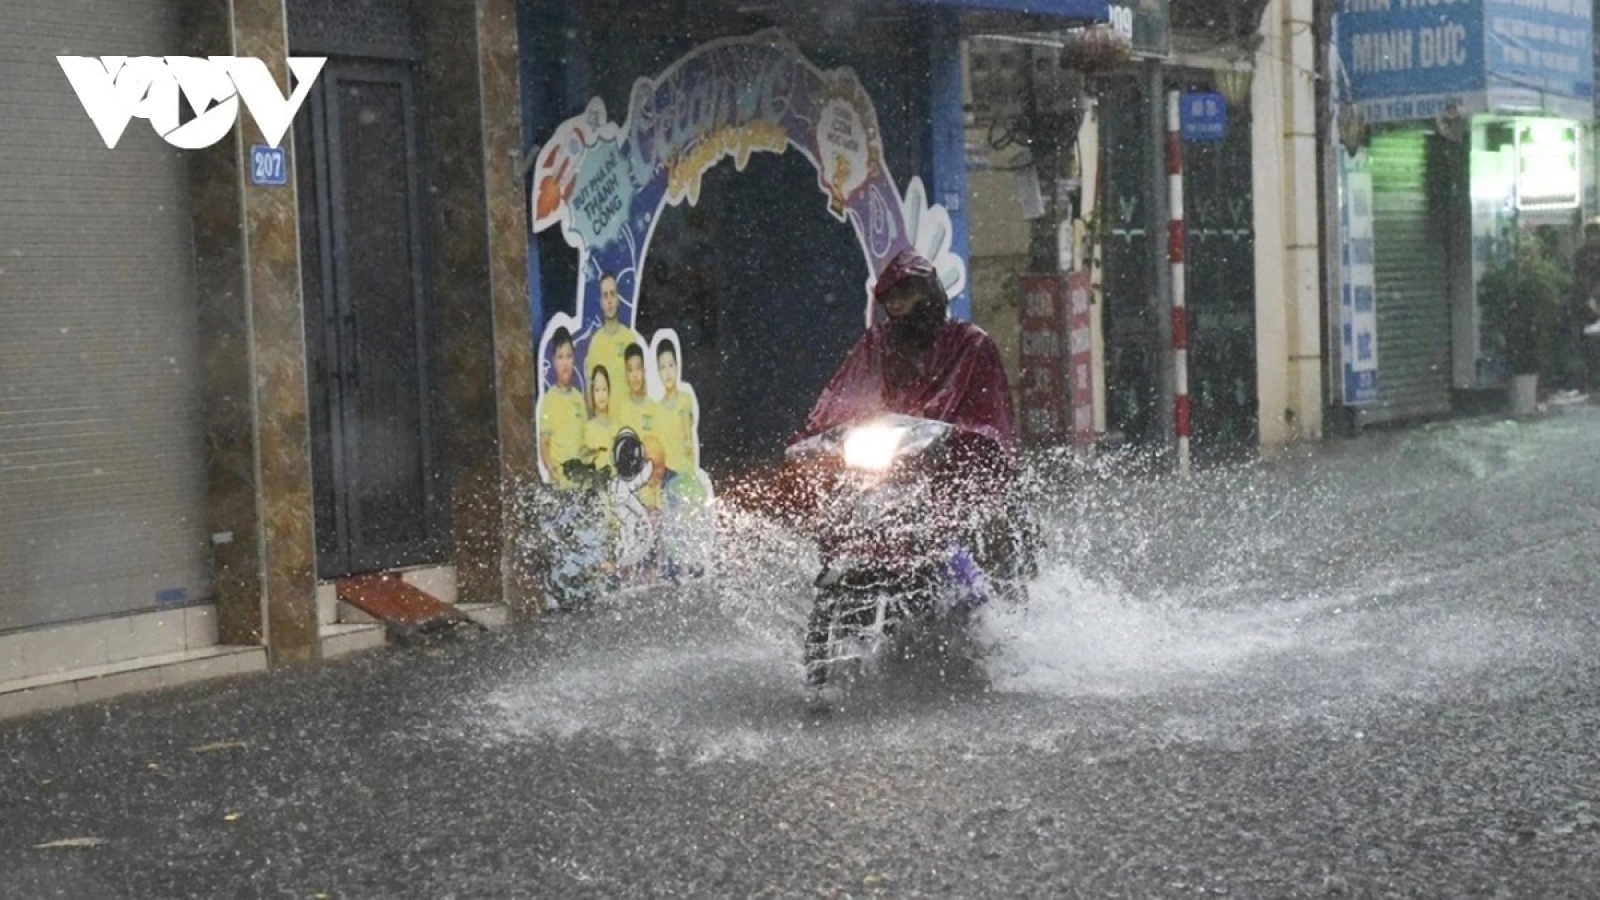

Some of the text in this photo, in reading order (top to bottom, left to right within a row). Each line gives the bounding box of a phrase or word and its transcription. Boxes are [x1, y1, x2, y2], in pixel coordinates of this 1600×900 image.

[1352, 30, 1412, 74] MINH
[1421, 15, 1465, 68] ĐỨC
[254, 152, 282, 177] 207
